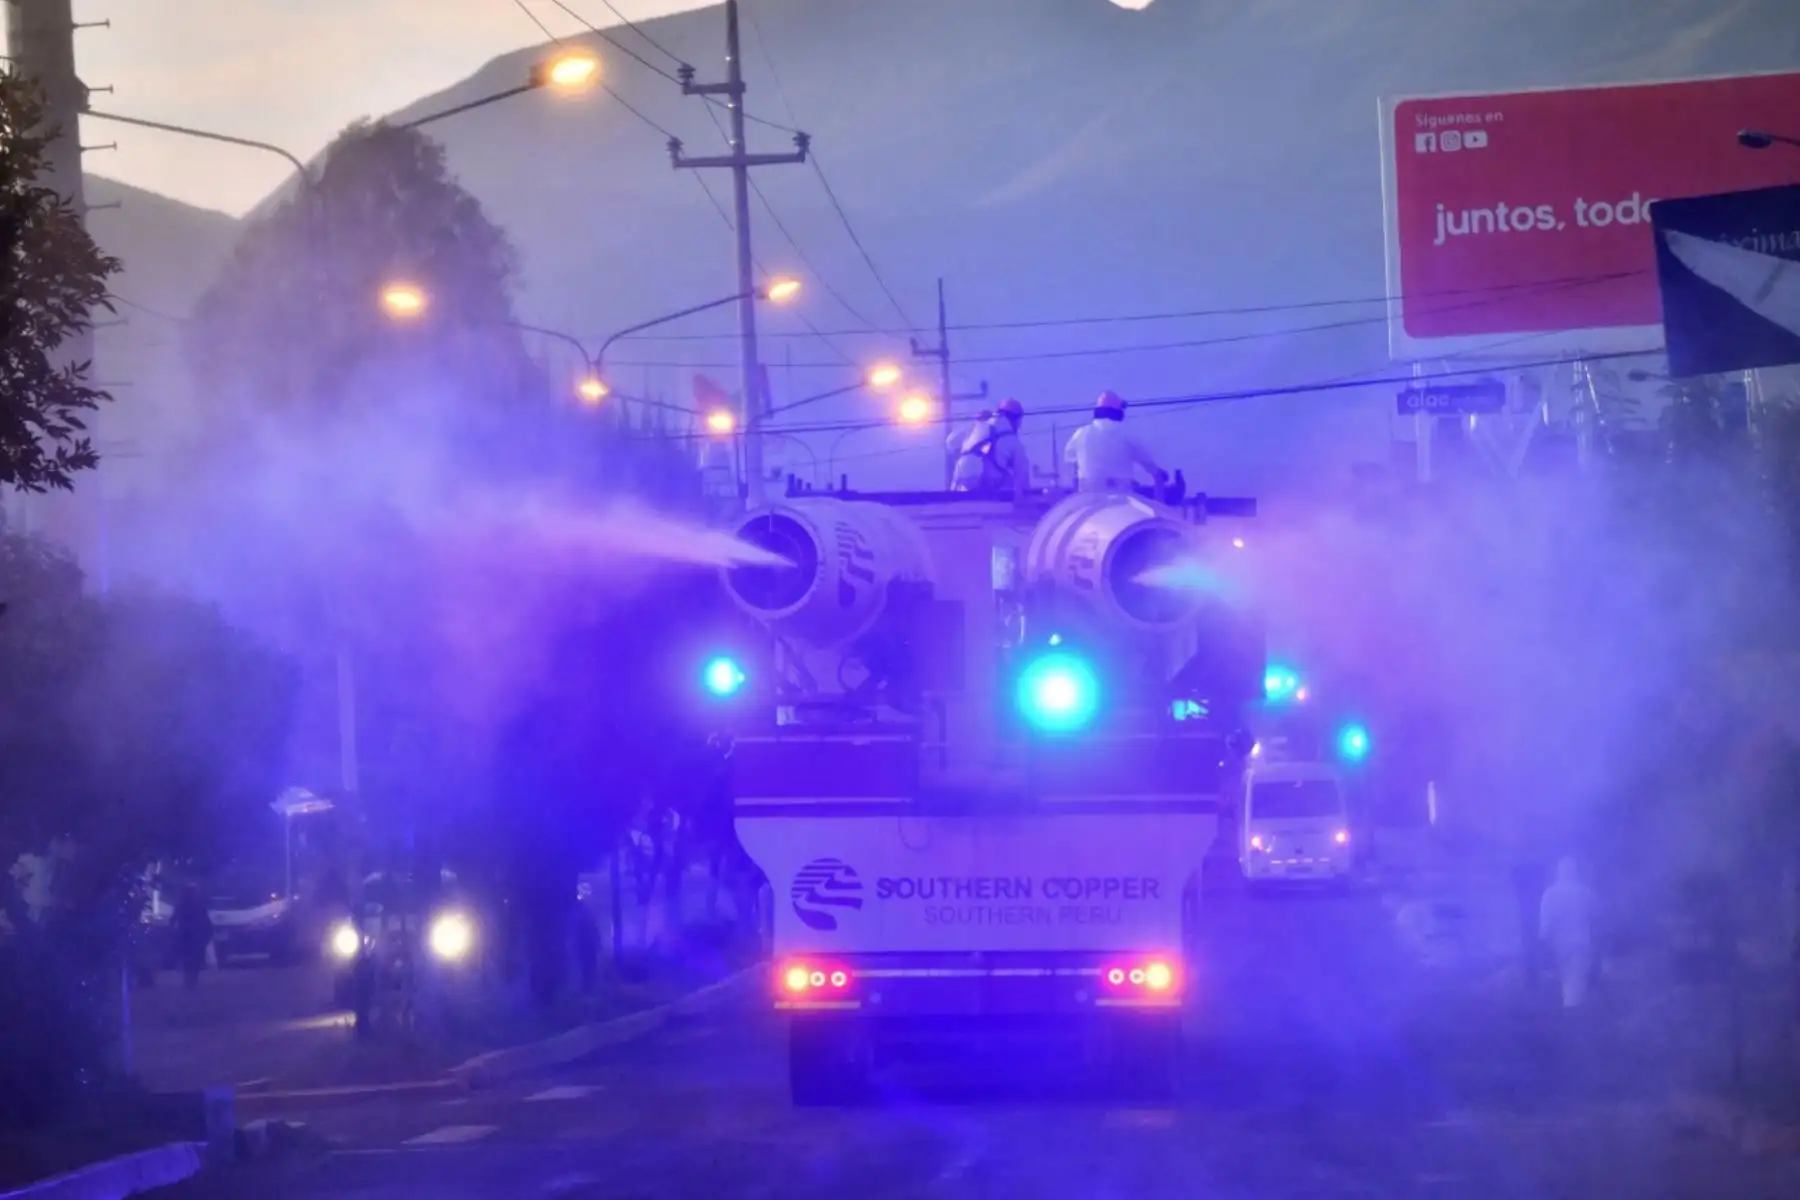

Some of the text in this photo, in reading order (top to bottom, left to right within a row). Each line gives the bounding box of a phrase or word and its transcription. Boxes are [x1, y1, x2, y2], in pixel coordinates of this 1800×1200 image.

[1484, 111, 1504, 123] en
[1433, 202, 1566, 246] juntos,
[875, 876, 1161, 900] SOUTHERN COPPER
[923, 905, 1122, 926] SOUTHERN PERU
